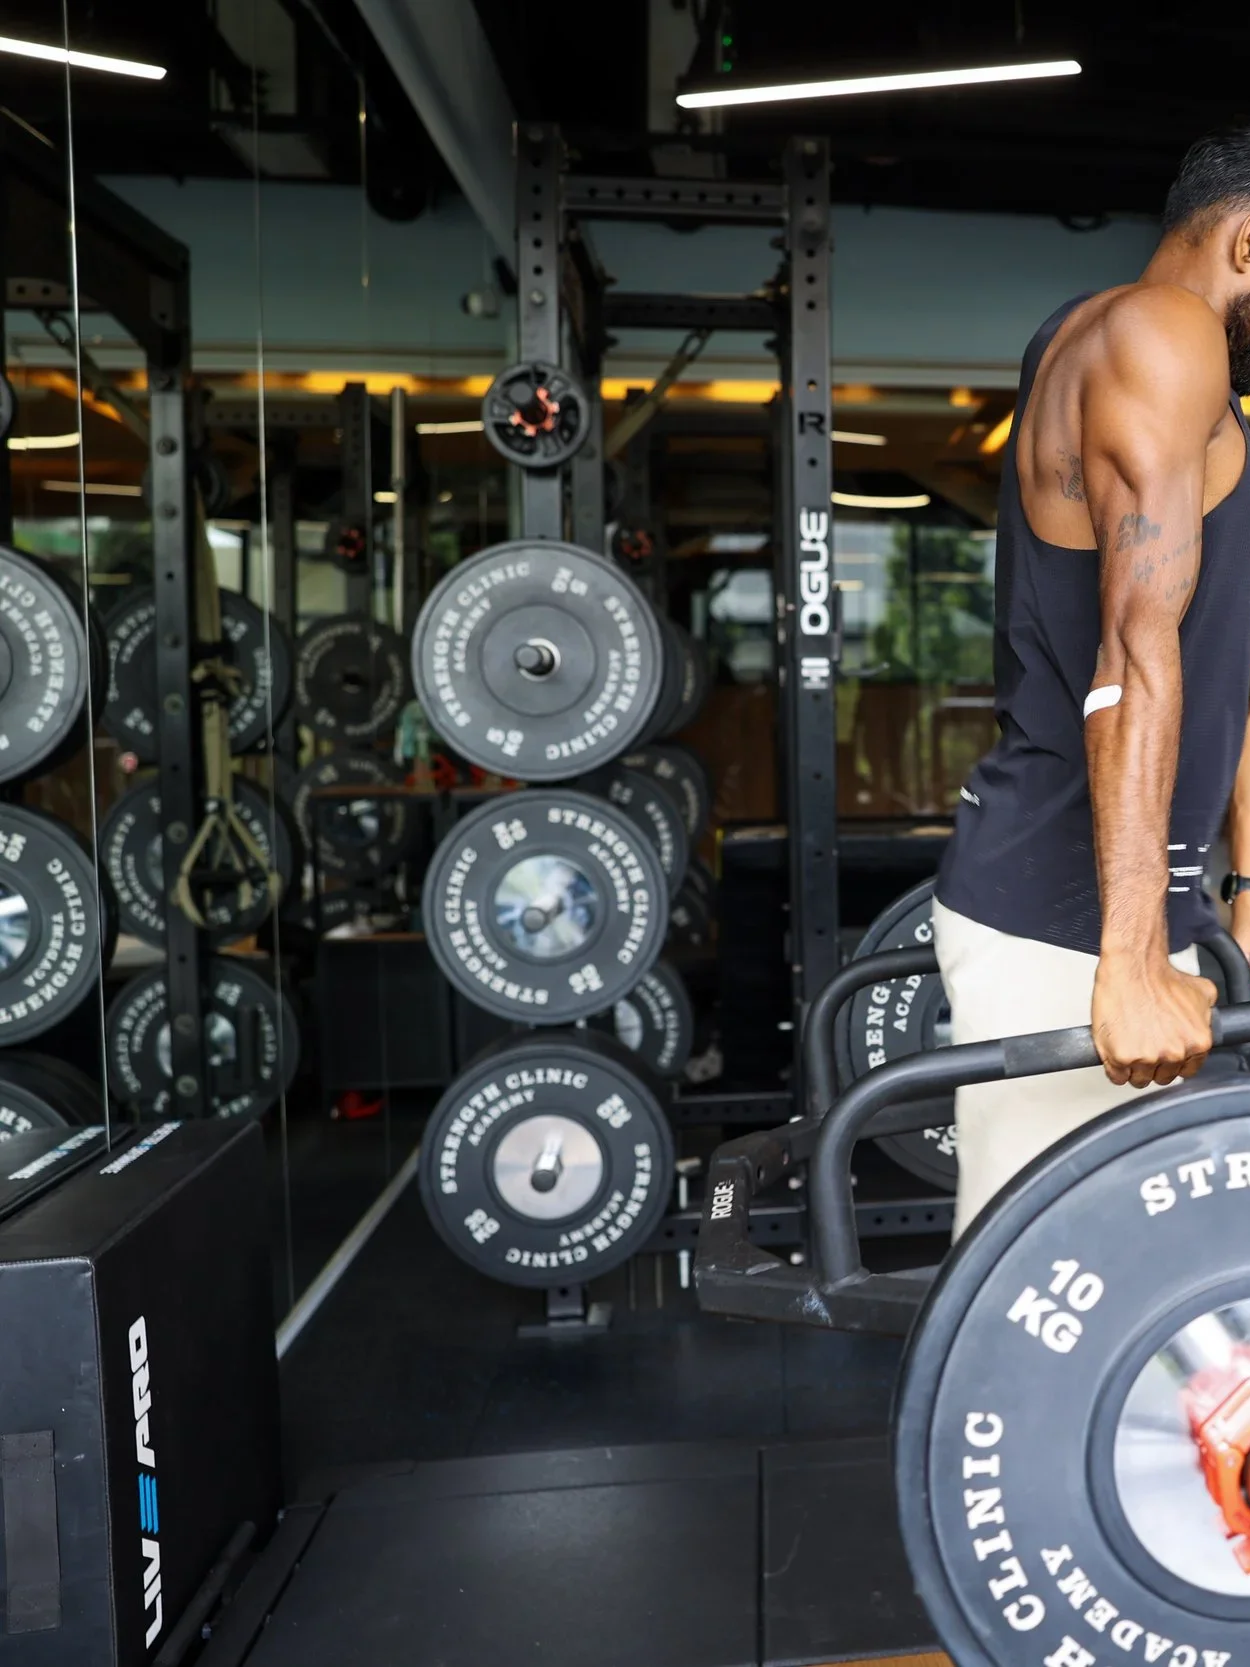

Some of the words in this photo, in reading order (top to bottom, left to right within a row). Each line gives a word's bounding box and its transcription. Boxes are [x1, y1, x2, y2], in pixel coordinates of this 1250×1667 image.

[457, 562, 530, 606] CLINIC
[545, 714, 618, 760] CLINIC
[445, 847, 477, 924] CLINIC
[548, 808, 645, 884] STRENGTH
[617, 888, 649, 965] CLINIC
[450, 929, 549, 1005] STRENGTH
[440, 1082, 502, 1194] STRENGTH
[505, 1068, 589, 1089] CLINIC
[468, 1089, 535, 1146] ACADEMY
[592, 1143, 652, 1252] STRENGTH
[711, 1183, 734, 1220] ROGUE
[506, 1246, 588, 1268] CLINIC
[1048, 1258, 1104, 1312] 10
[1006, 1285, 1084, 1354] KG
[963, 1411, 1046, 1631] CLINIC
[1040, 1544, 1231, 1667] ACADEMY
